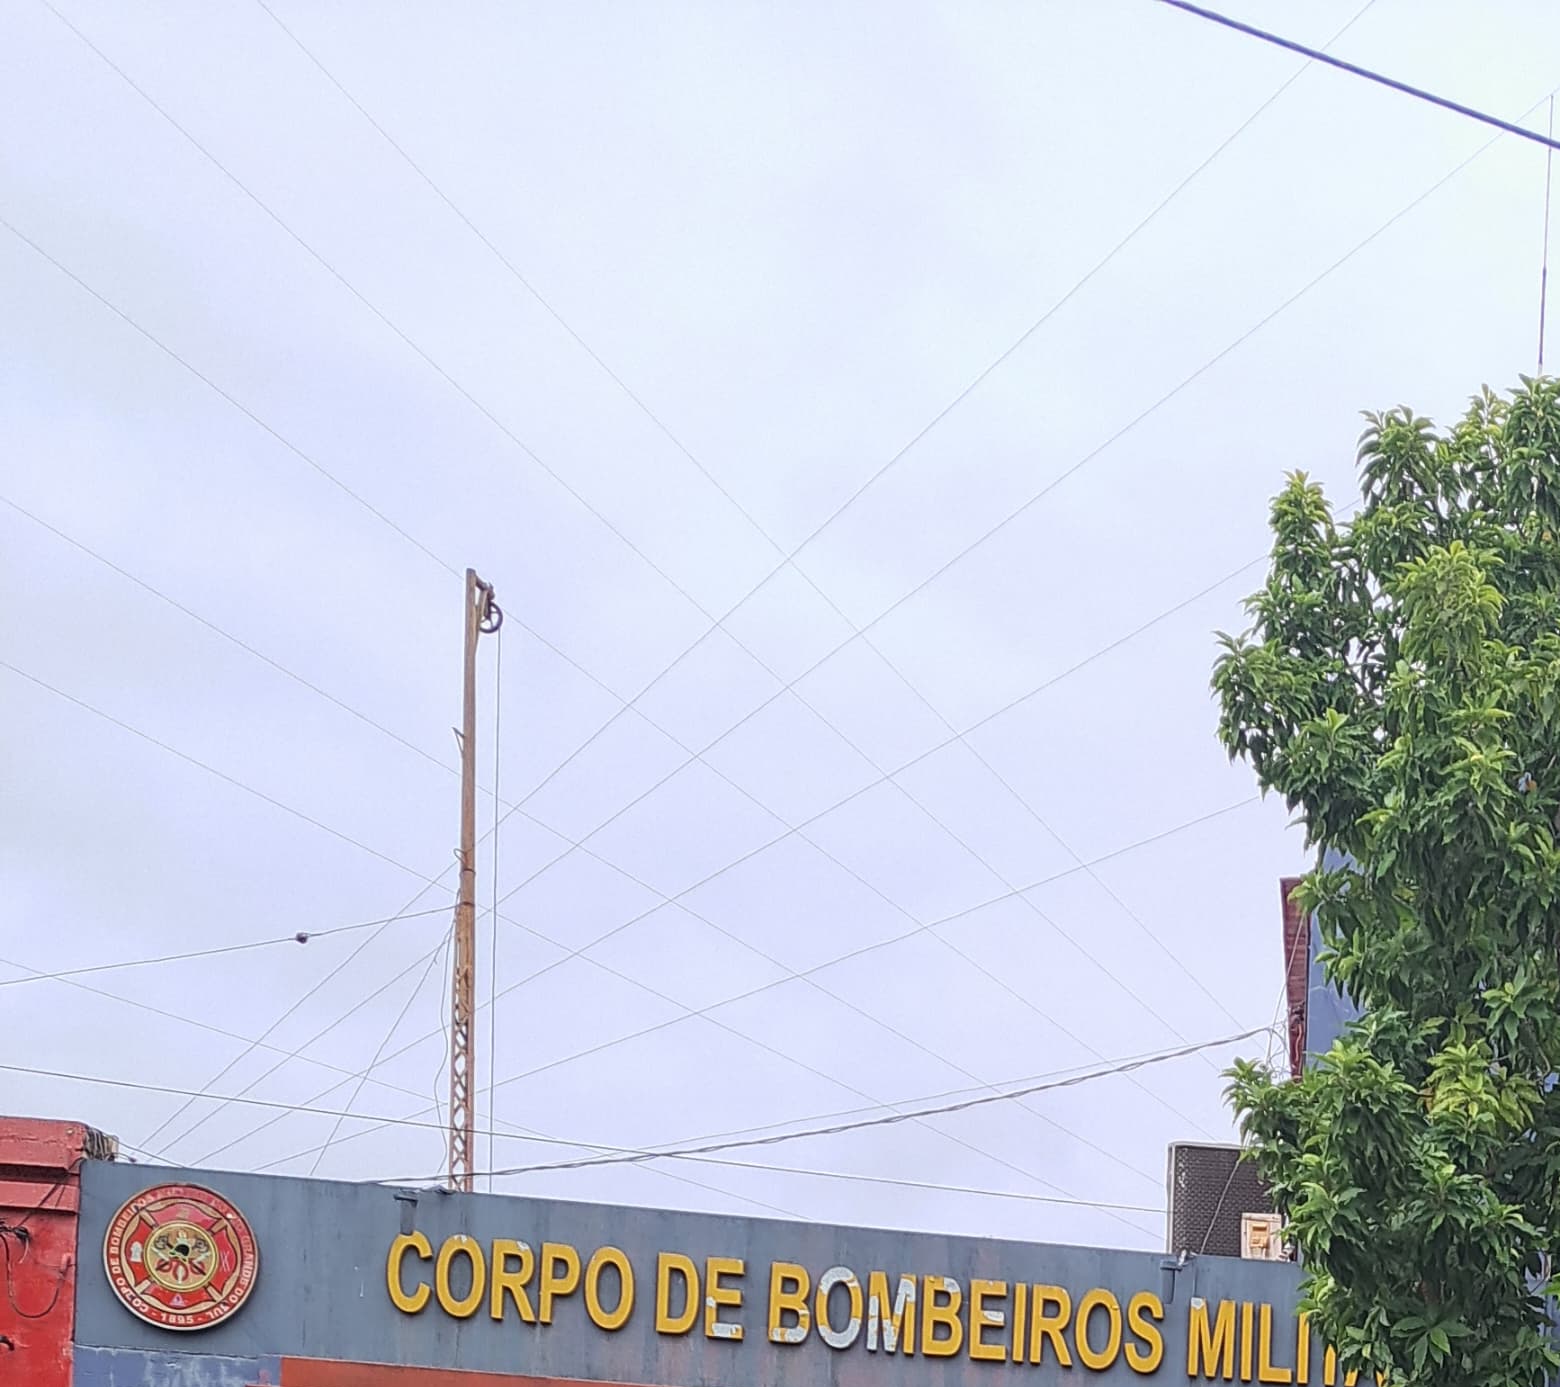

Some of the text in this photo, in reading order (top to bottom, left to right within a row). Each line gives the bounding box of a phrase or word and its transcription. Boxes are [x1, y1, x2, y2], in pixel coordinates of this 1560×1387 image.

[160, 1312, 195, 1325] 1895
[386, 1230, 636, 1333] CORPO
[656, 1252, 746, 1341] DE
[767, 1260, 1164, 1375] BOMBEIROS
